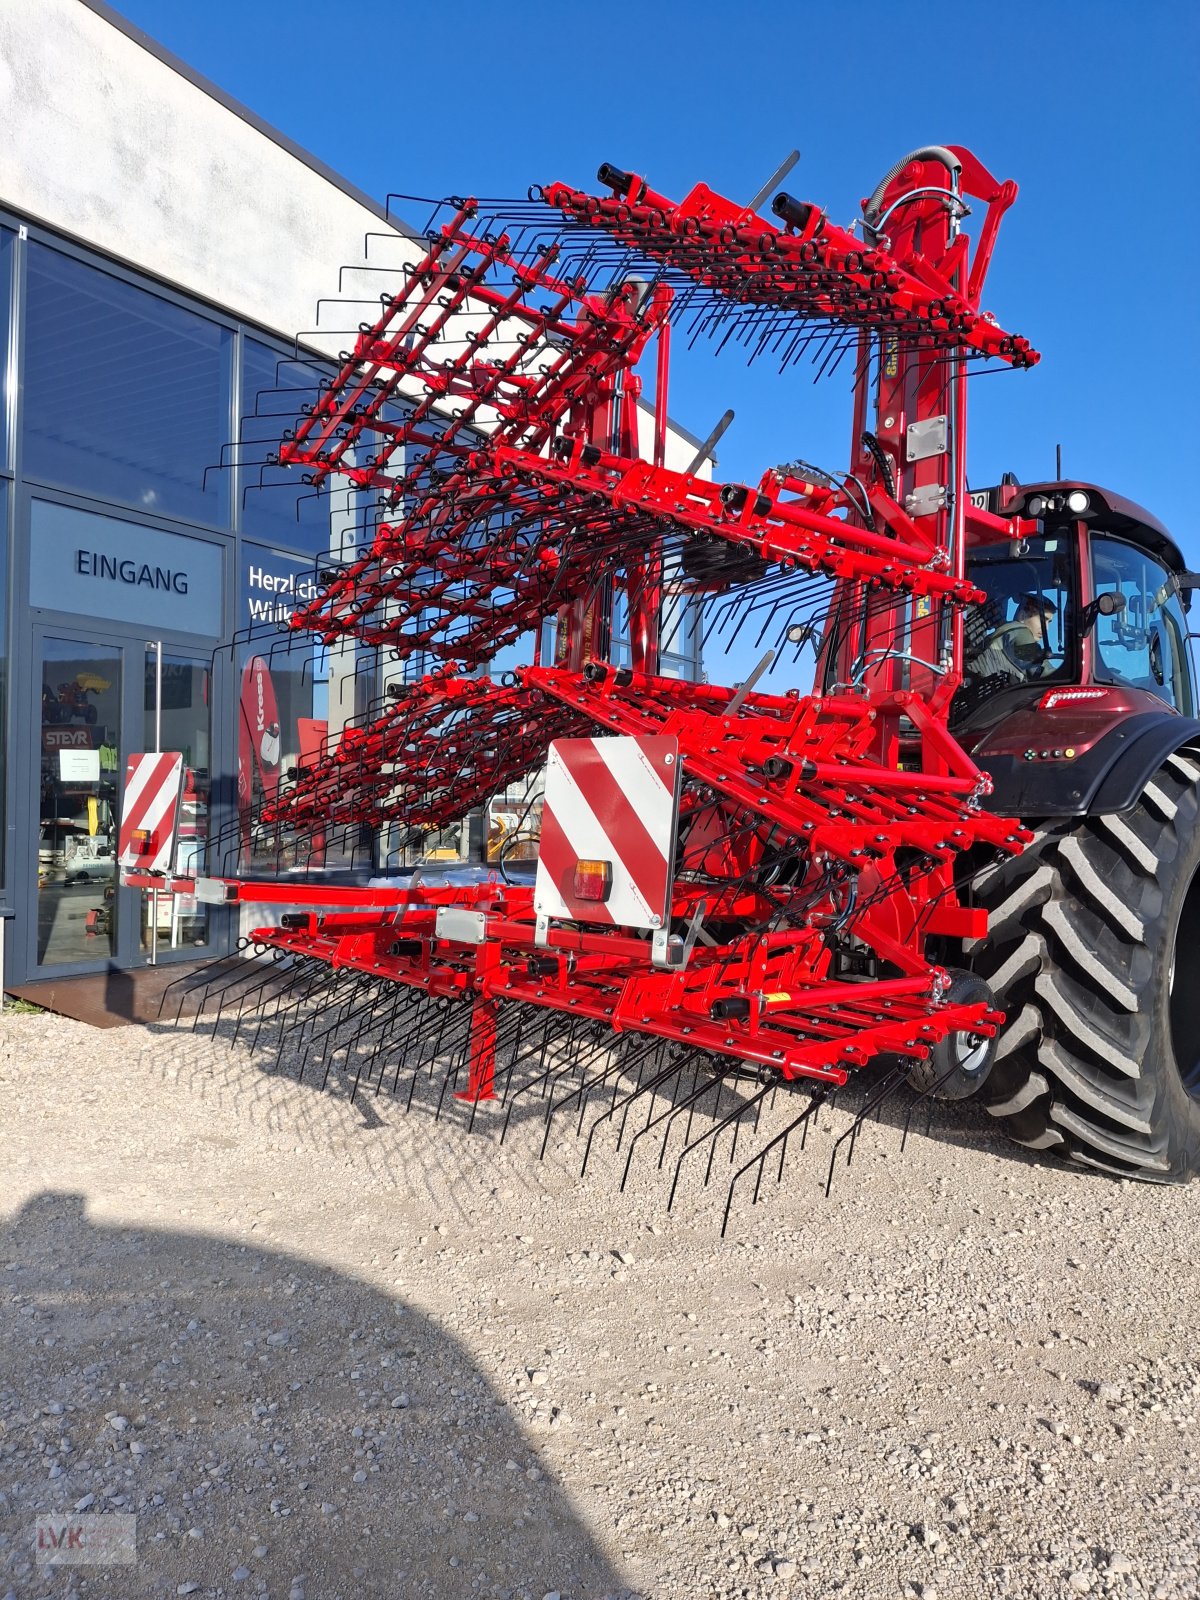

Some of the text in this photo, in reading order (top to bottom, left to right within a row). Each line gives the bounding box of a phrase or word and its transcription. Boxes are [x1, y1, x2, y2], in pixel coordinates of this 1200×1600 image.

[77, 549, 188, 594] EINGANG
[249, 565, 318, 599] Herzlch
[248, 598, 292, 624] Willk
[257, 671, 265, 731] Kress
[46, 731, 88, 745] STEYR
